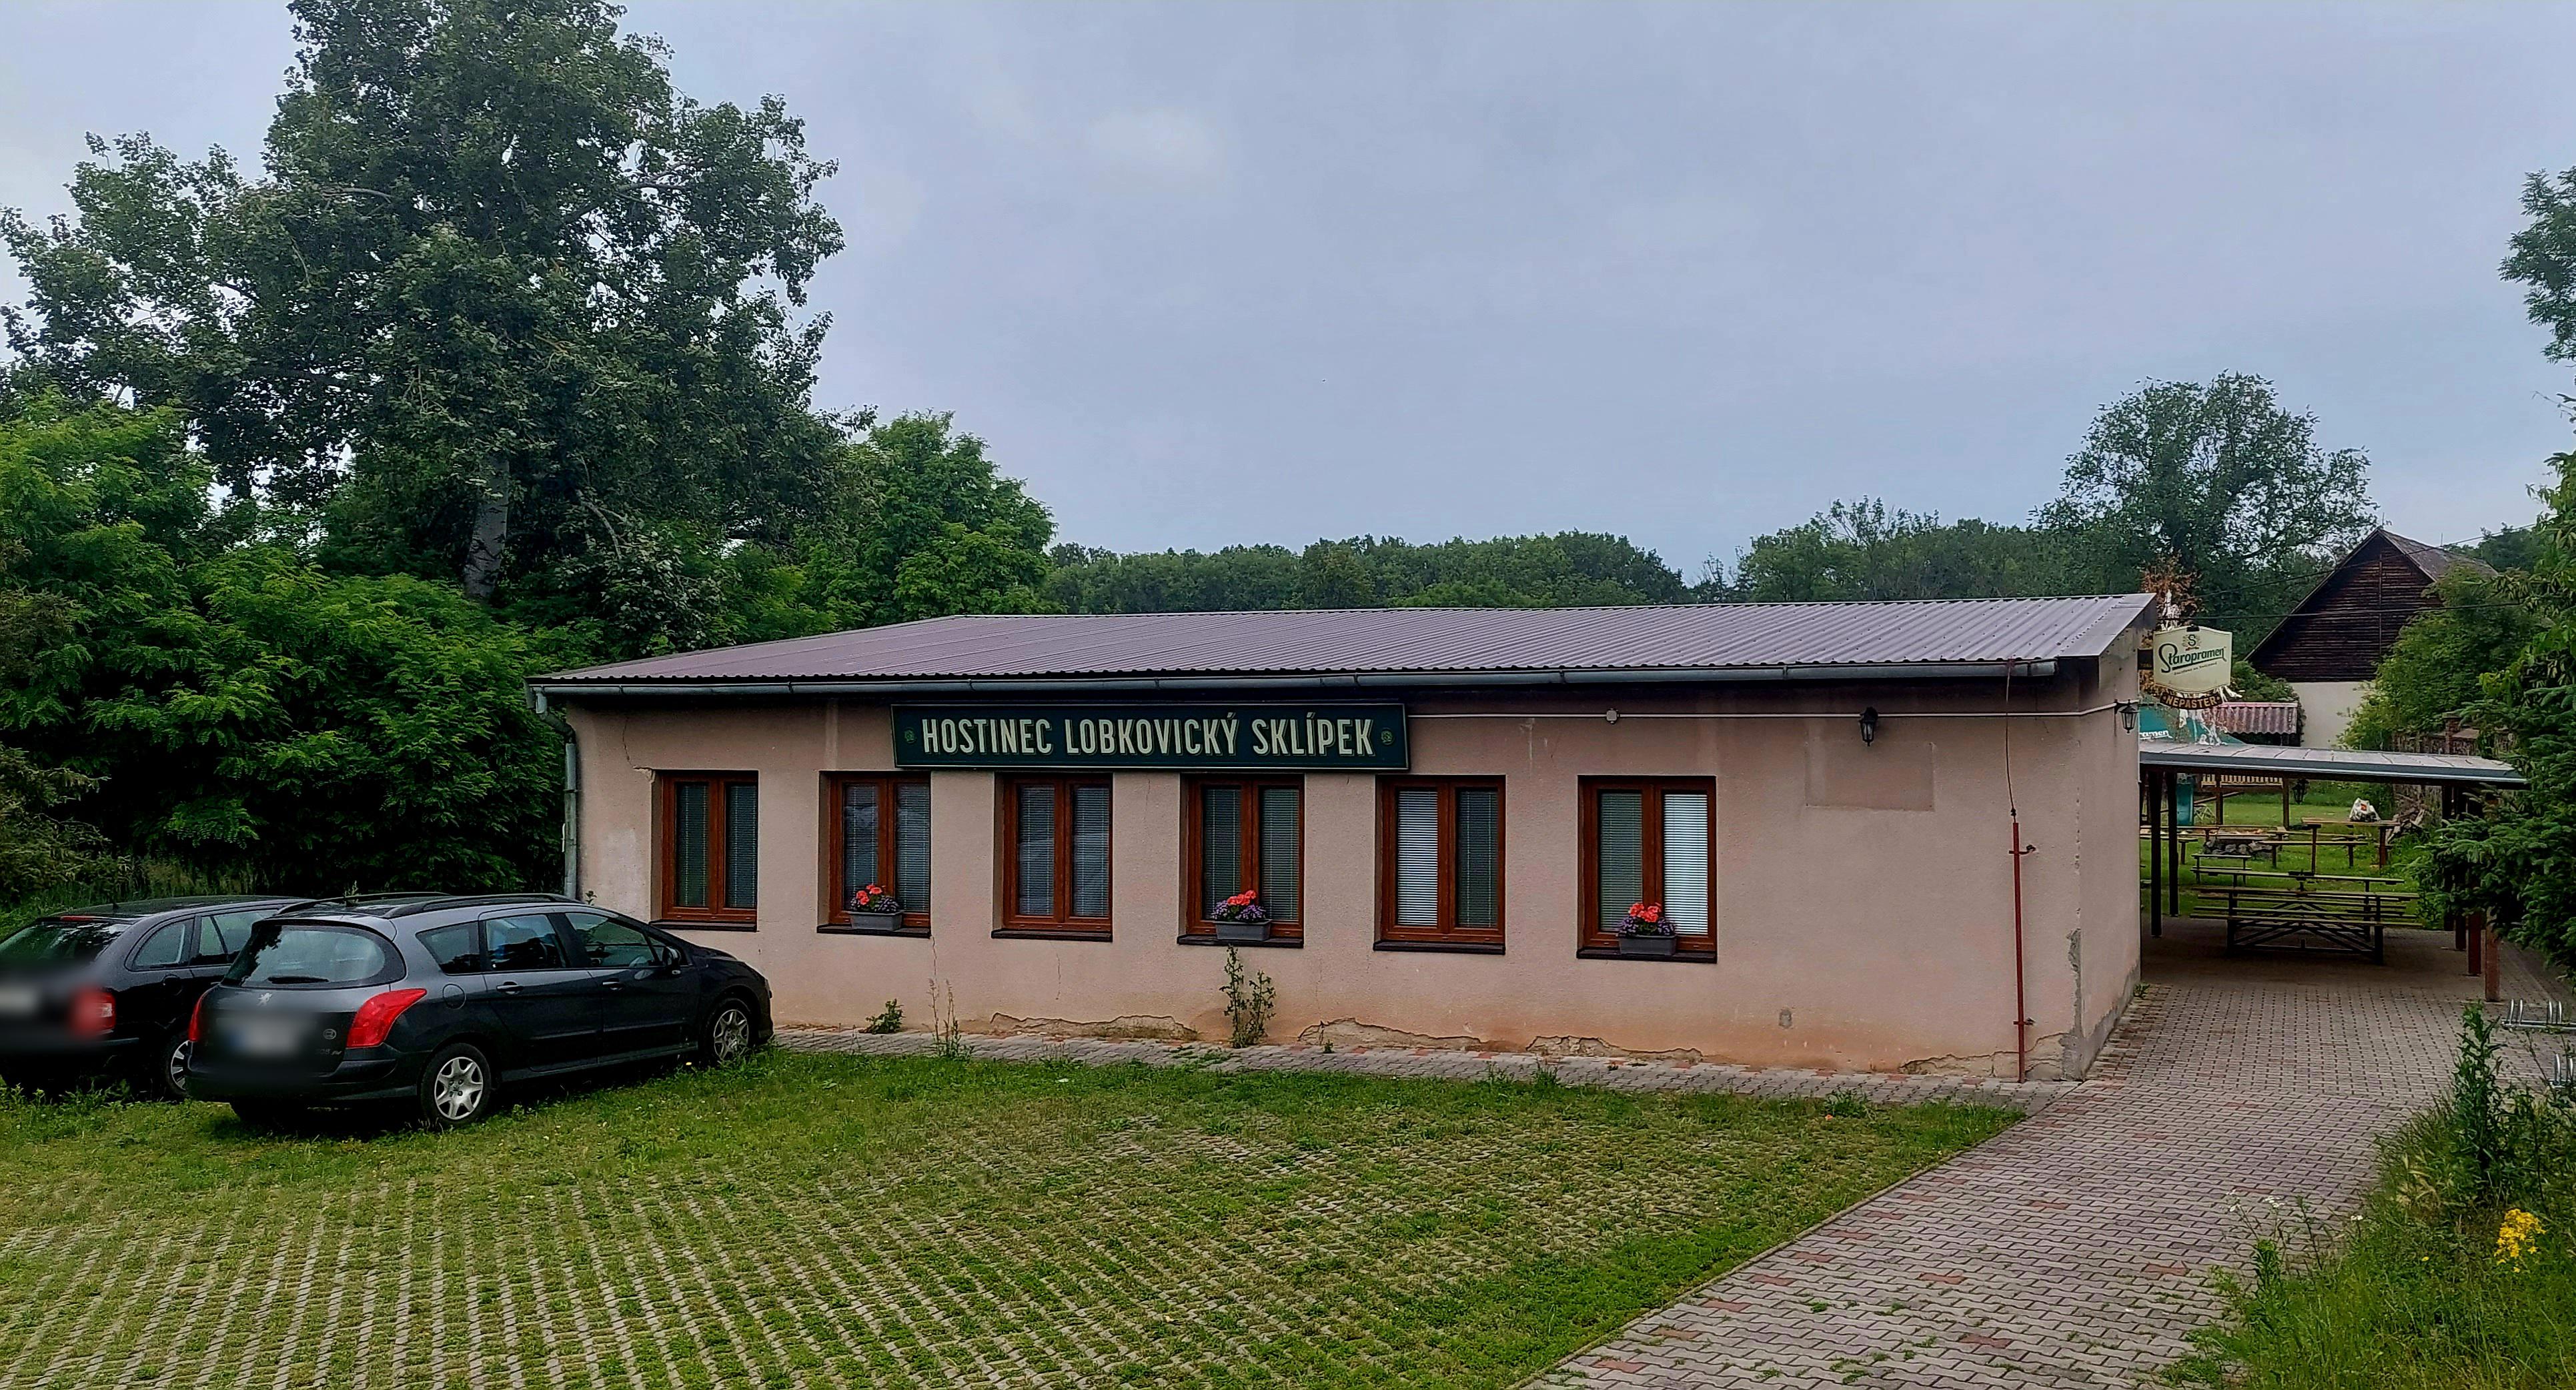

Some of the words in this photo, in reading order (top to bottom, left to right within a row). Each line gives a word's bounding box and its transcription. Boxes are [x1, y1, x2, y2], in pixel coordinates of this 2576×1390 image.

[2158, 643, 2226, 673] Staropramen
[2165, 695, 2217, 708] NEPASTER
[922, 718, 1054, 755] HOSTINEC
[1065, 712, 1239, 756] LOBKOVICKÝ
[1251, 712, 1375, 756] SKLÍPEK
